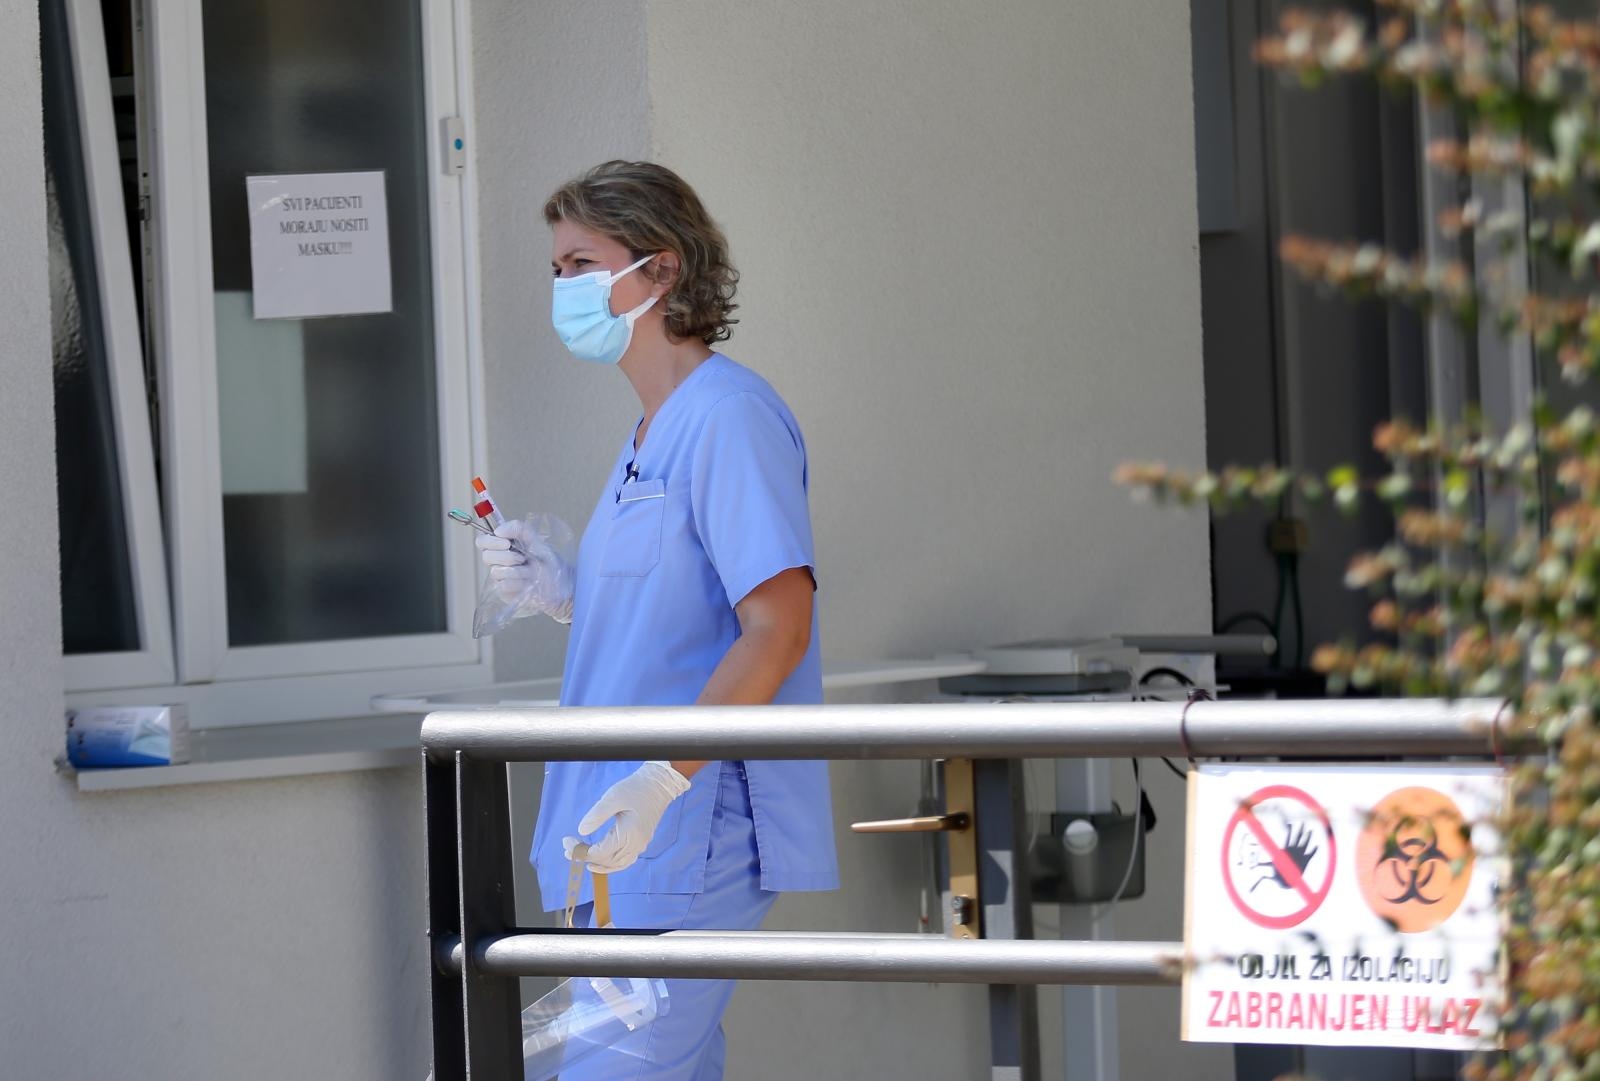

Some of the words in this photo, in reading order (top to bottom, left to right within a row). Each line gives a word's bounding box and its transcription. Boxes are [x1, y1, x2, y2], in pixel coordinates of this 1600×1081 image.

[282, 197, 302, 211] SVI
[280, 220, 327, 234] MORAJU
[330, 218, 369, 232] NOSITI
[1309, 955, 1333, 981] ZA
[1342, 955, 1450, 984] IZOLACIJU
[1206, 990, 1388, 1032] ZABRANJEN
[1403, 995, 1482, 1037] ULAZ
